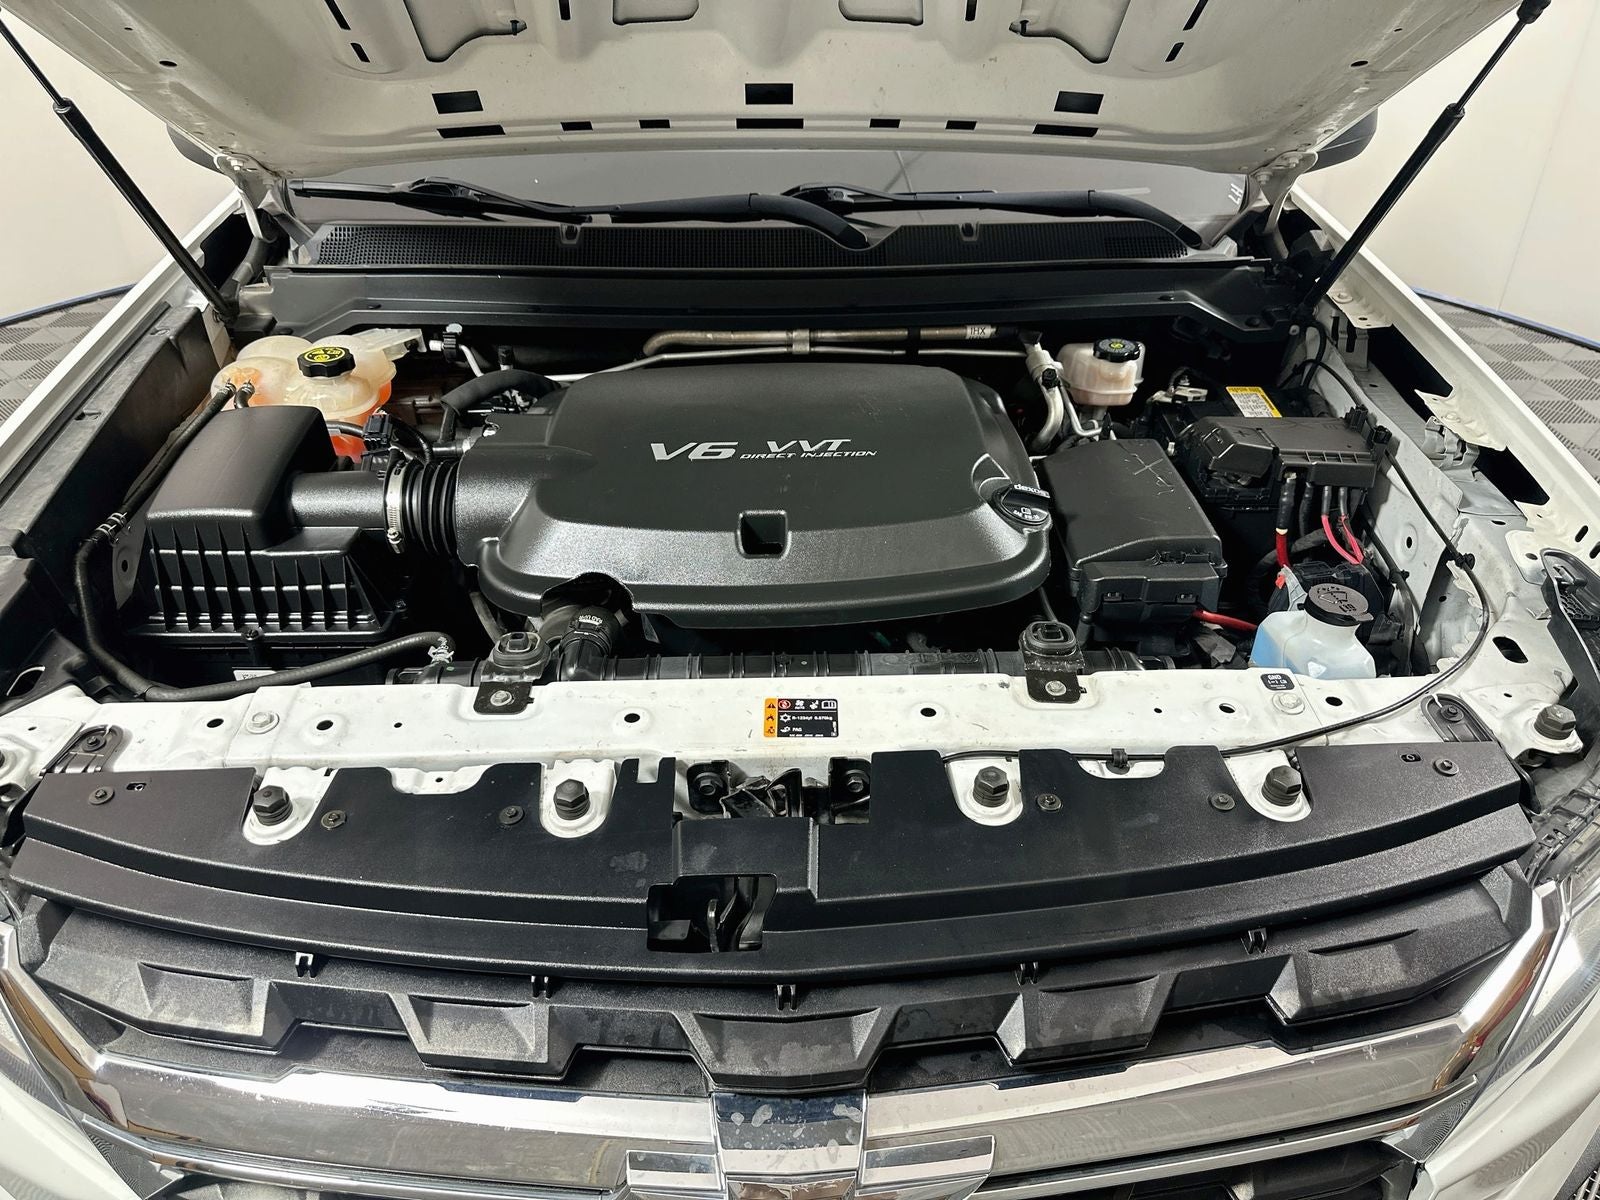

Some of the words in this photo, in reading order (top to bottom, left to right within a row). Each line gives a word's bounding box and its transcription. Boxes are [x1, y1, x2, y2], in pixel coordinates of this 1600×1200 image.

[650, 441, 739, 461] V6
[766, 438, 852, 453] VVT
[739, 452, 796, 460] DIRECT
[800, 450, 878, 459] INJECTION
